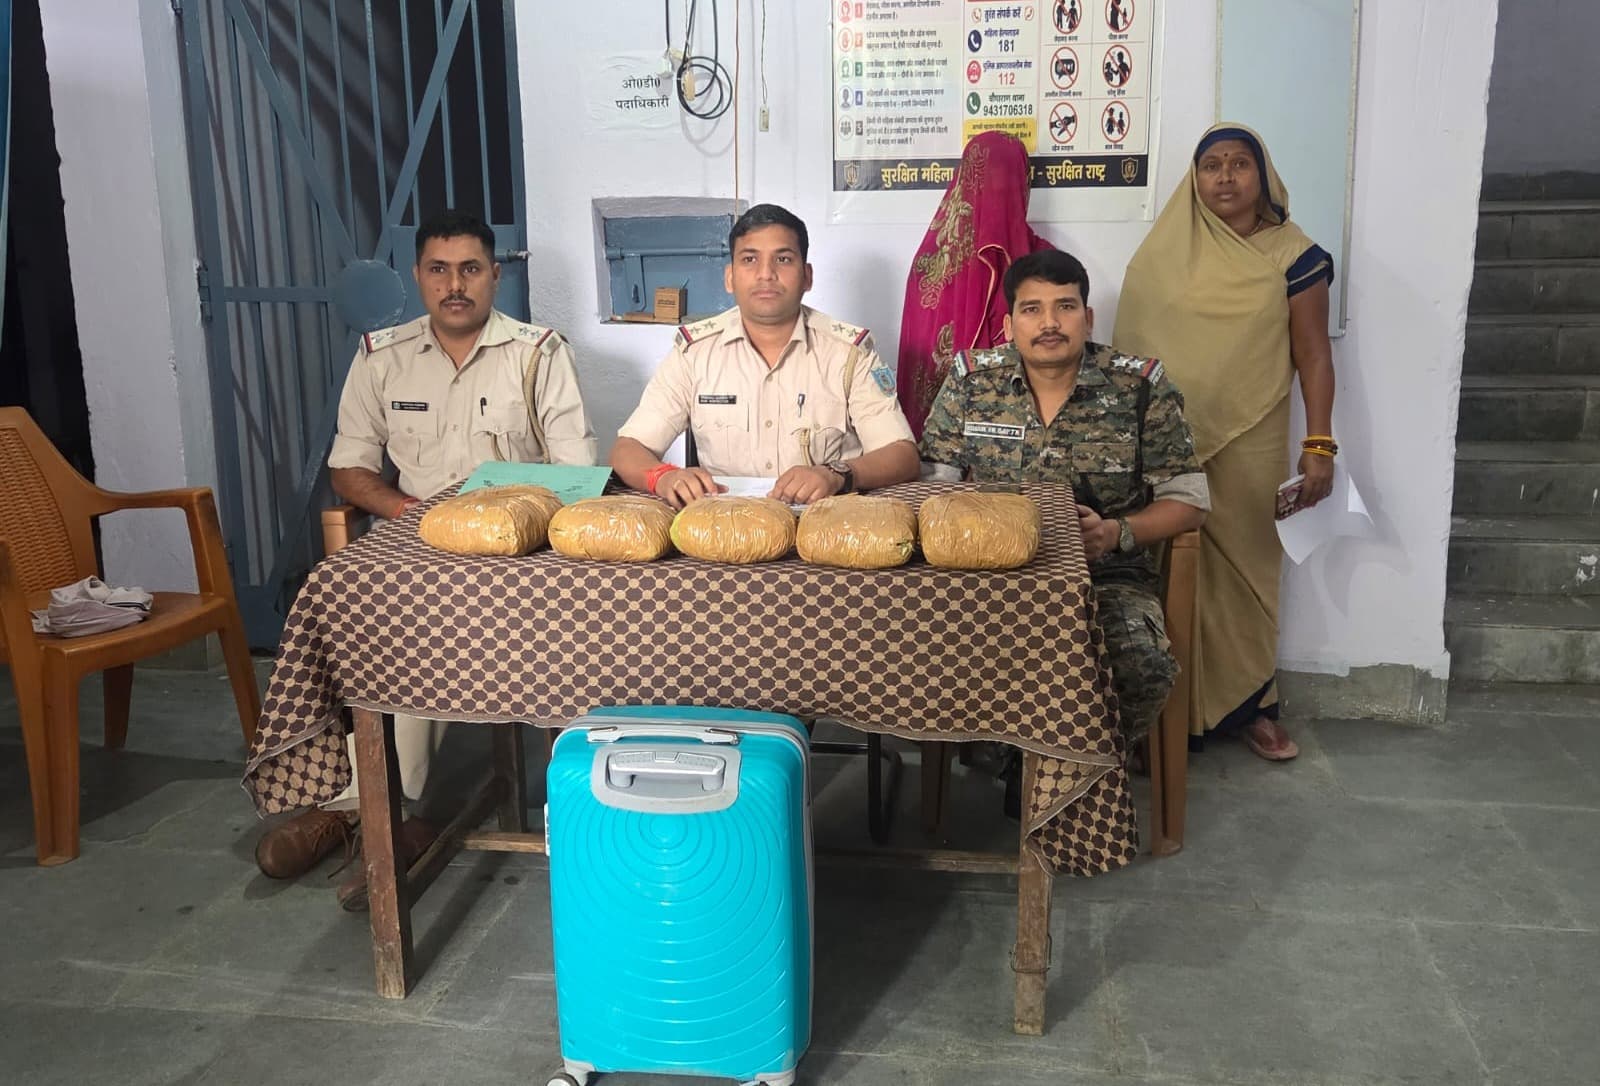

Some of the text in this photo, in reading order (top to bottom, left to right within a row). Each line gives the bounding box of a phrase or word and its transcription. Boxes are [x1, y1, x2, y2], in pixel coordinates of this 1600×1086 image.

[997, 7, 1011, 19] संपर्क
[998, 39, 1014, 53] 181
[998, 72, 1015, 85] 112
[615, 95, 669, 109] पदाधिकारी
[983, 104, 1033, 117] 9431706318
[881, 162, 955, 188] सुरक्षित महिला
[1045, 159, 1084, 185] सुरक्षित
[1085, 164, 1106, 182] राष्ट्र
